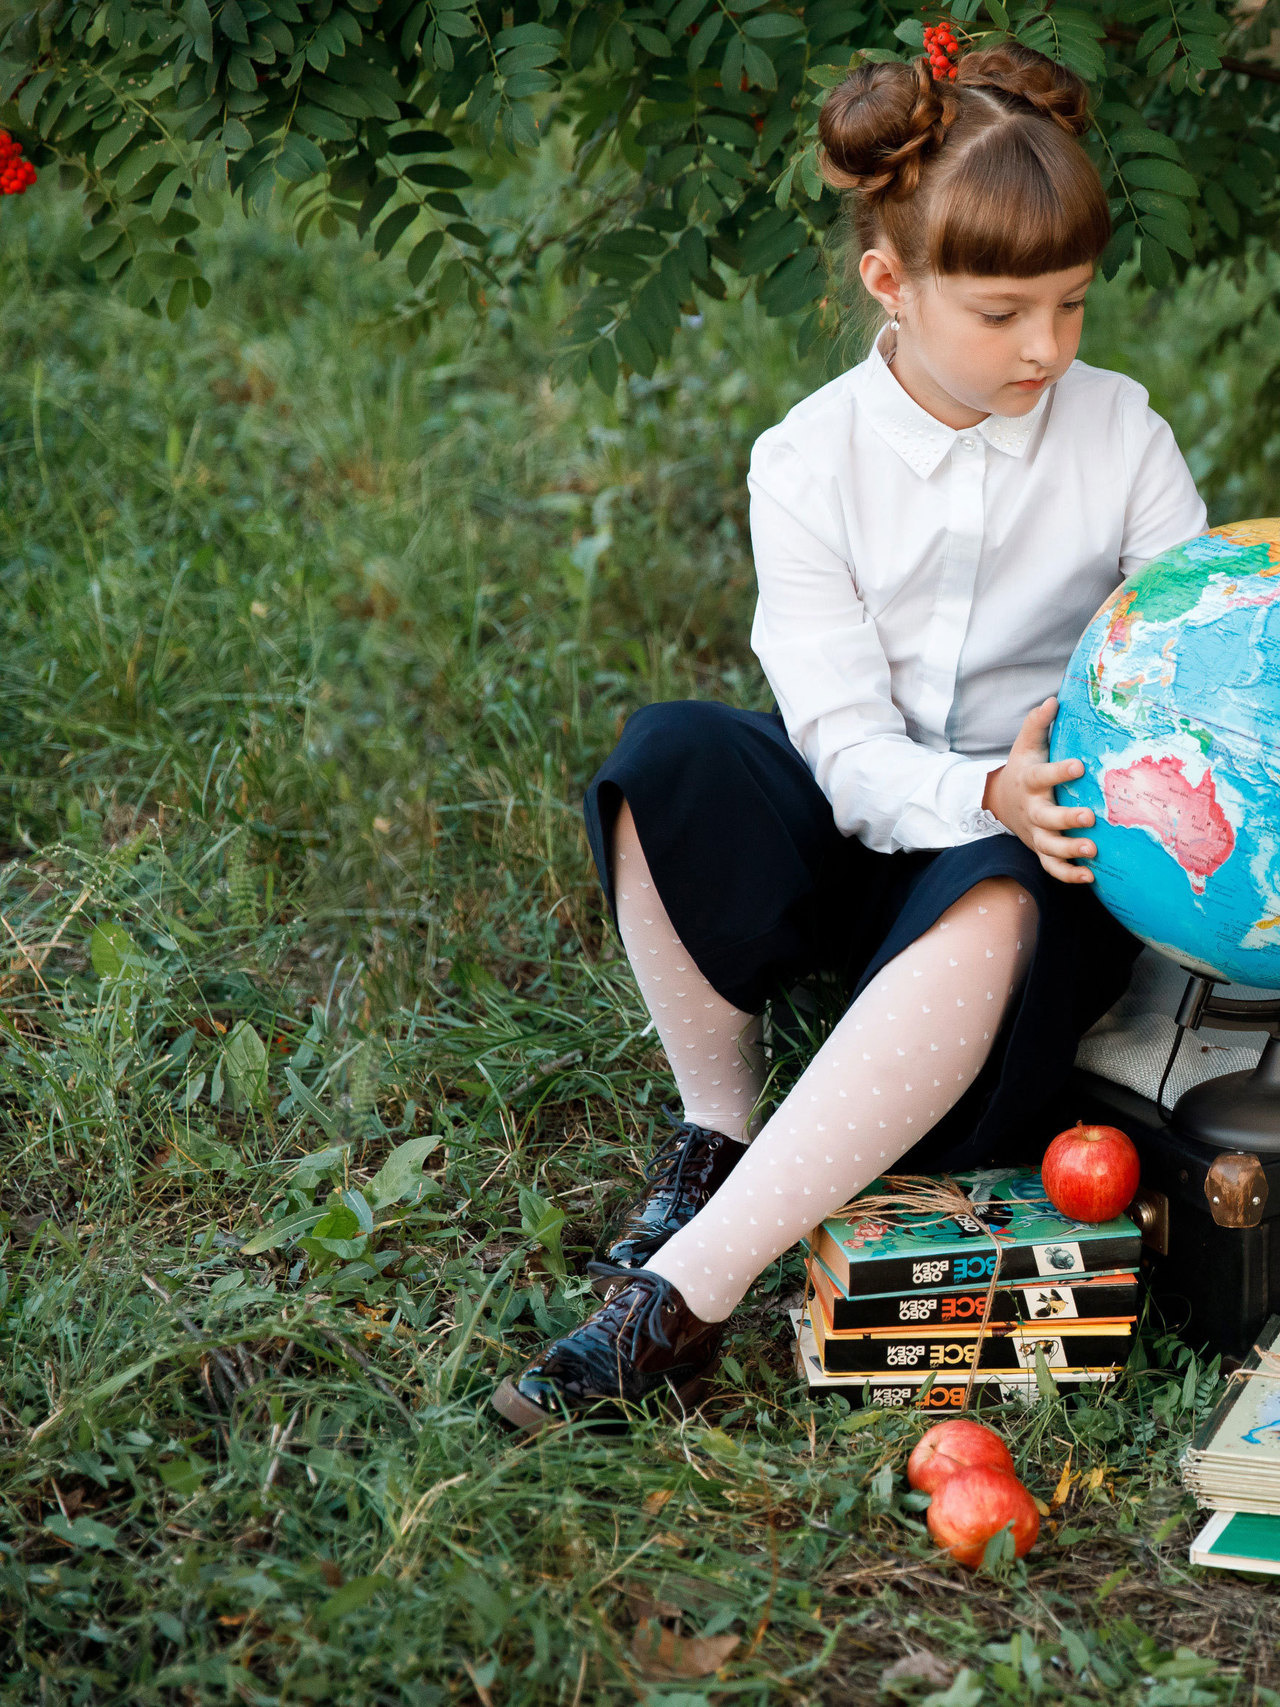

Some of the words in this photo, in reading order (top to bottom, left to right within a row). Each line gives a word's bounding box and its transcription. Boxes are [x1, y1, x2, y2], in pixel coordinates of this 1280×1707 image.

[912, 1260, 949, 1274] ВСЕМ
[912, 1271, 943, 1284] ОБО
[900, 1299, 937, 1310] ВСЕМ
[899, 1309, 930, 1320] ОБО
[887, 1345, 925, 1356] ВСЕМ
[887, 1355, 918, 1366] ОБО
[873, 1388, 911, 1398] ВСЕМ
